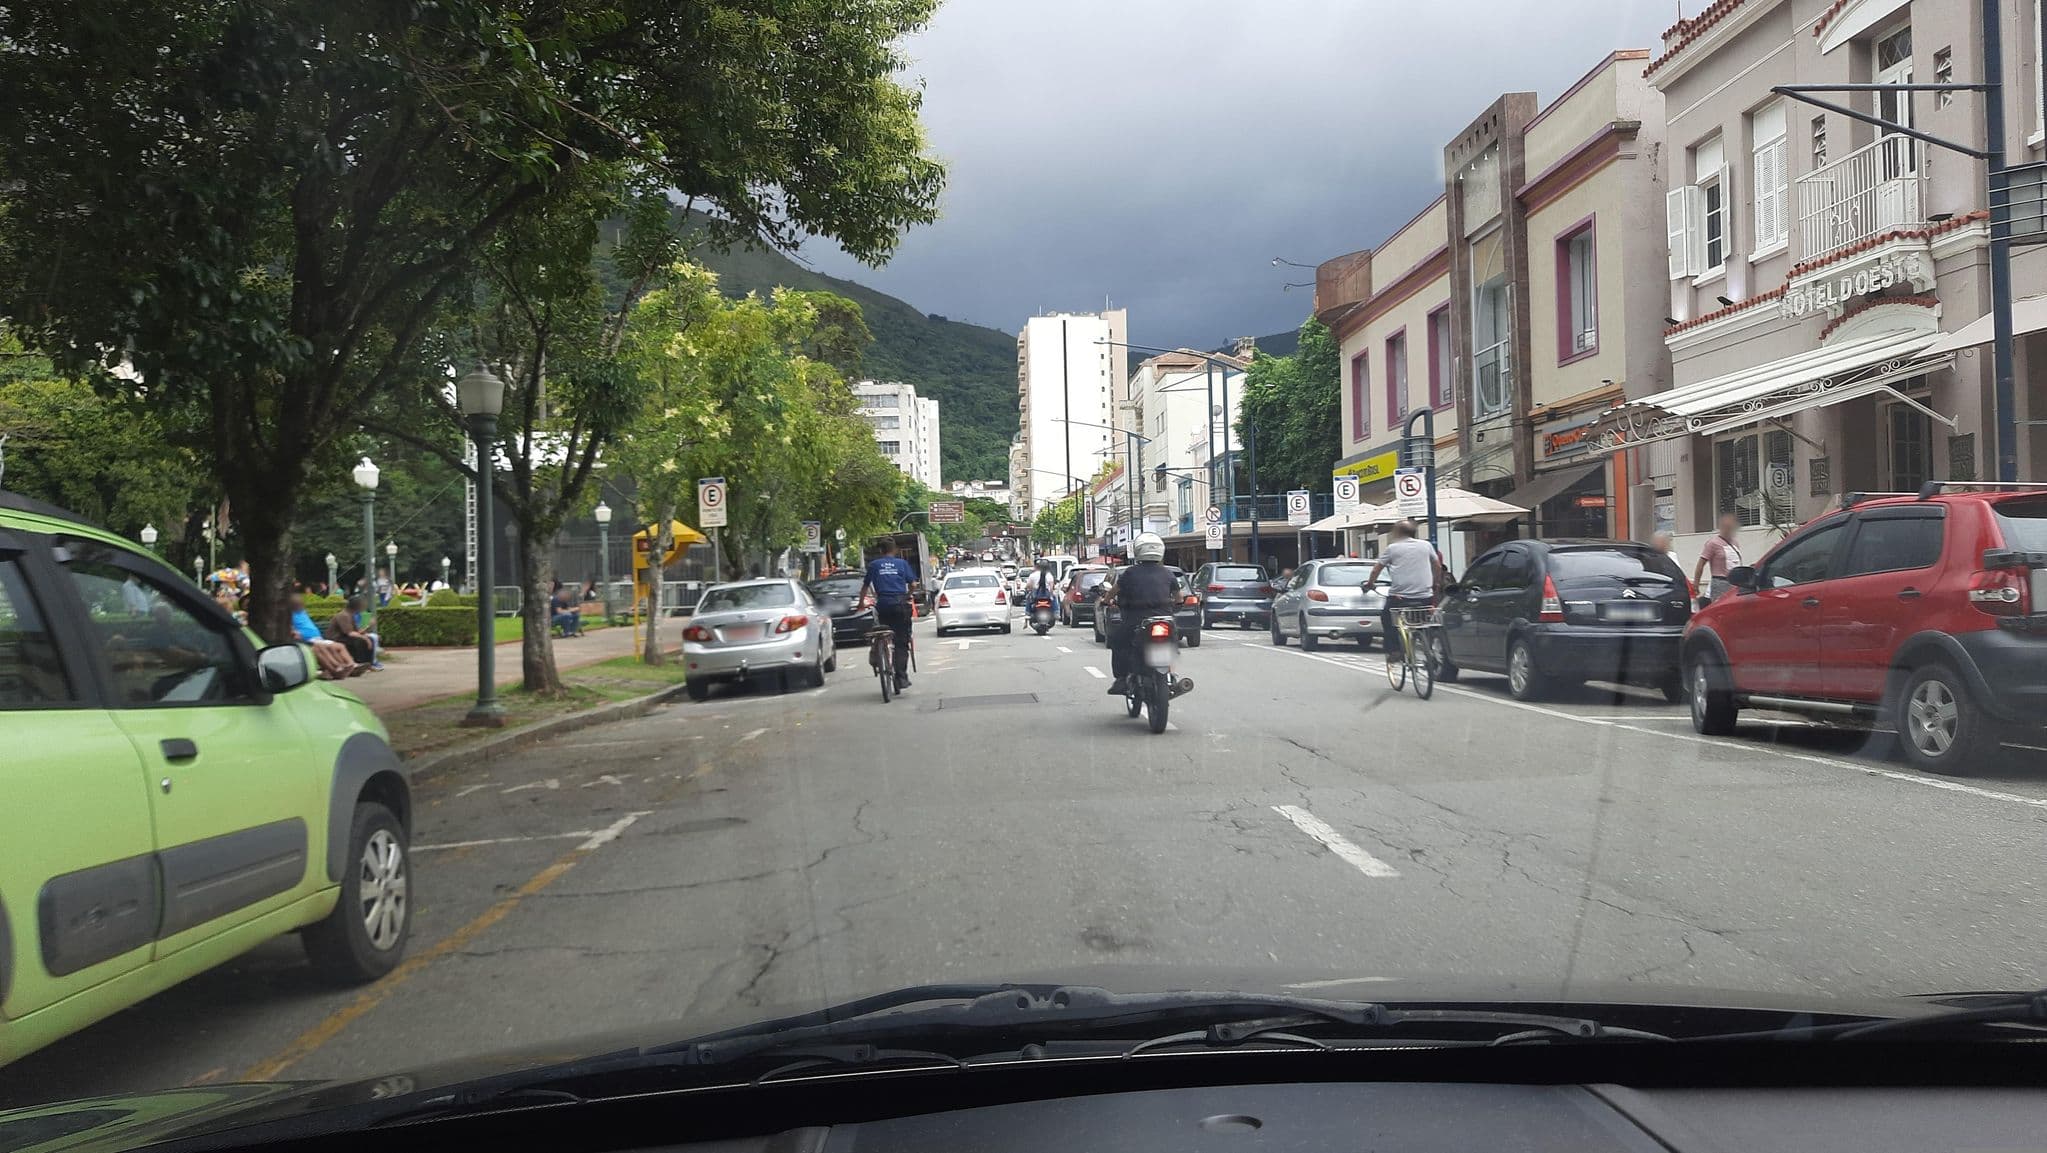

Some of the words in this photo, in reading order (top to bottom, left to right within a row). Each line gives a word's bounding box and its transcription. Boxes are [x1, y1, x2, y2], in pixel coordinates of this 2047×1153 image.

[1779, 281, 1837, 319] HOTEL
[1342, 484, 1350, 496] E
[1406, 478, 1415, 492] E
[708, 489, 717, 502] E
[1295, 498, 1302, 508] E
[1211, 528, 1217, 536] E
